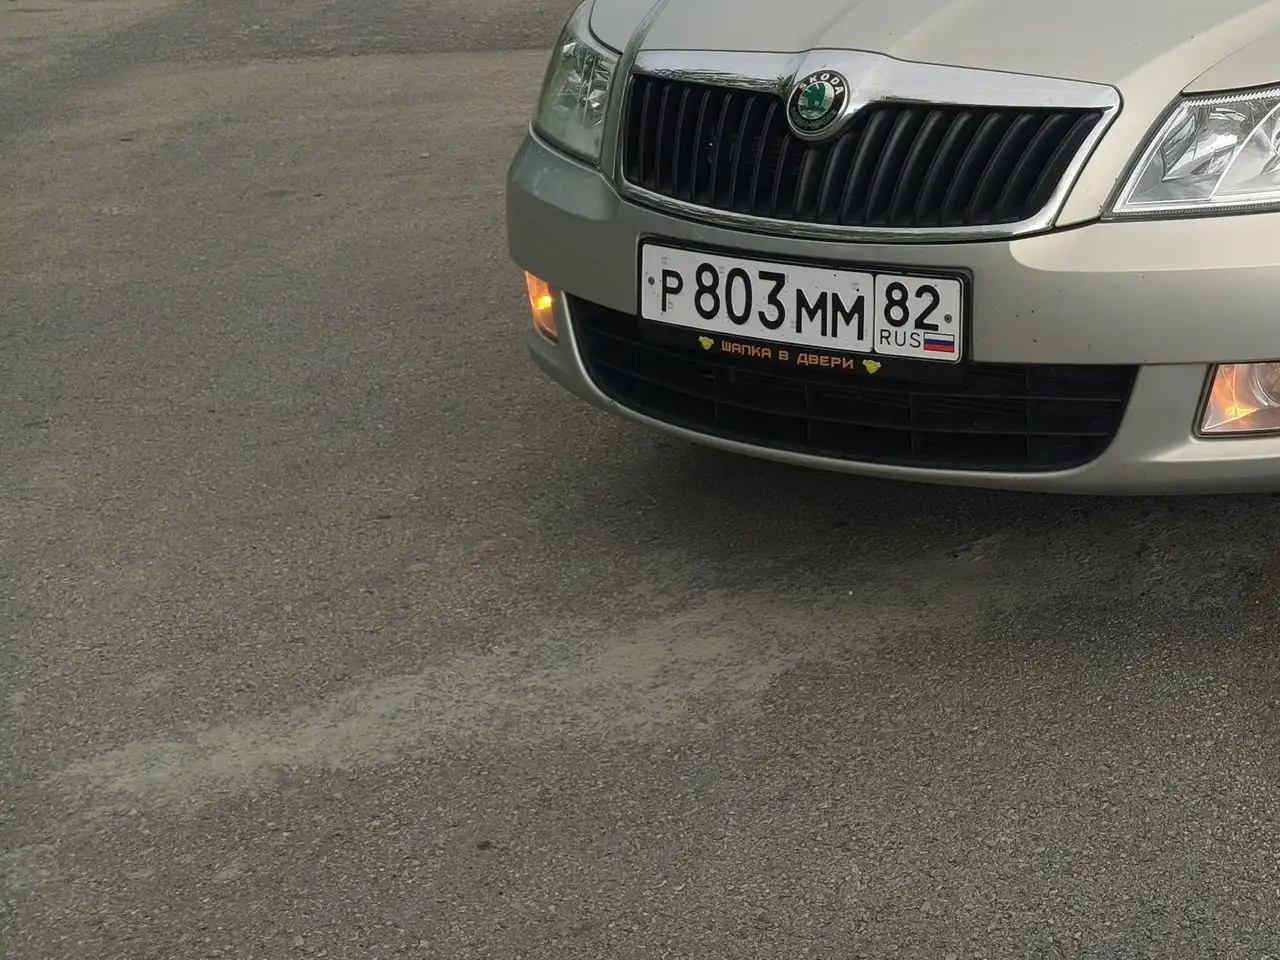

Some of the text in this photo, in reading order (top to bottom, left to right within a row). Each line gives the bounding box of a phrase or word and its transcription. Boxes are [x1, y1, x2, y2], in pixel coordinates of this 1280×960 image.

[884, 281, 941, 331] 82
[879, 328, 921, 348] RUS
[721, 340, 854, 369] ШАПКА В ДВЕРИ
